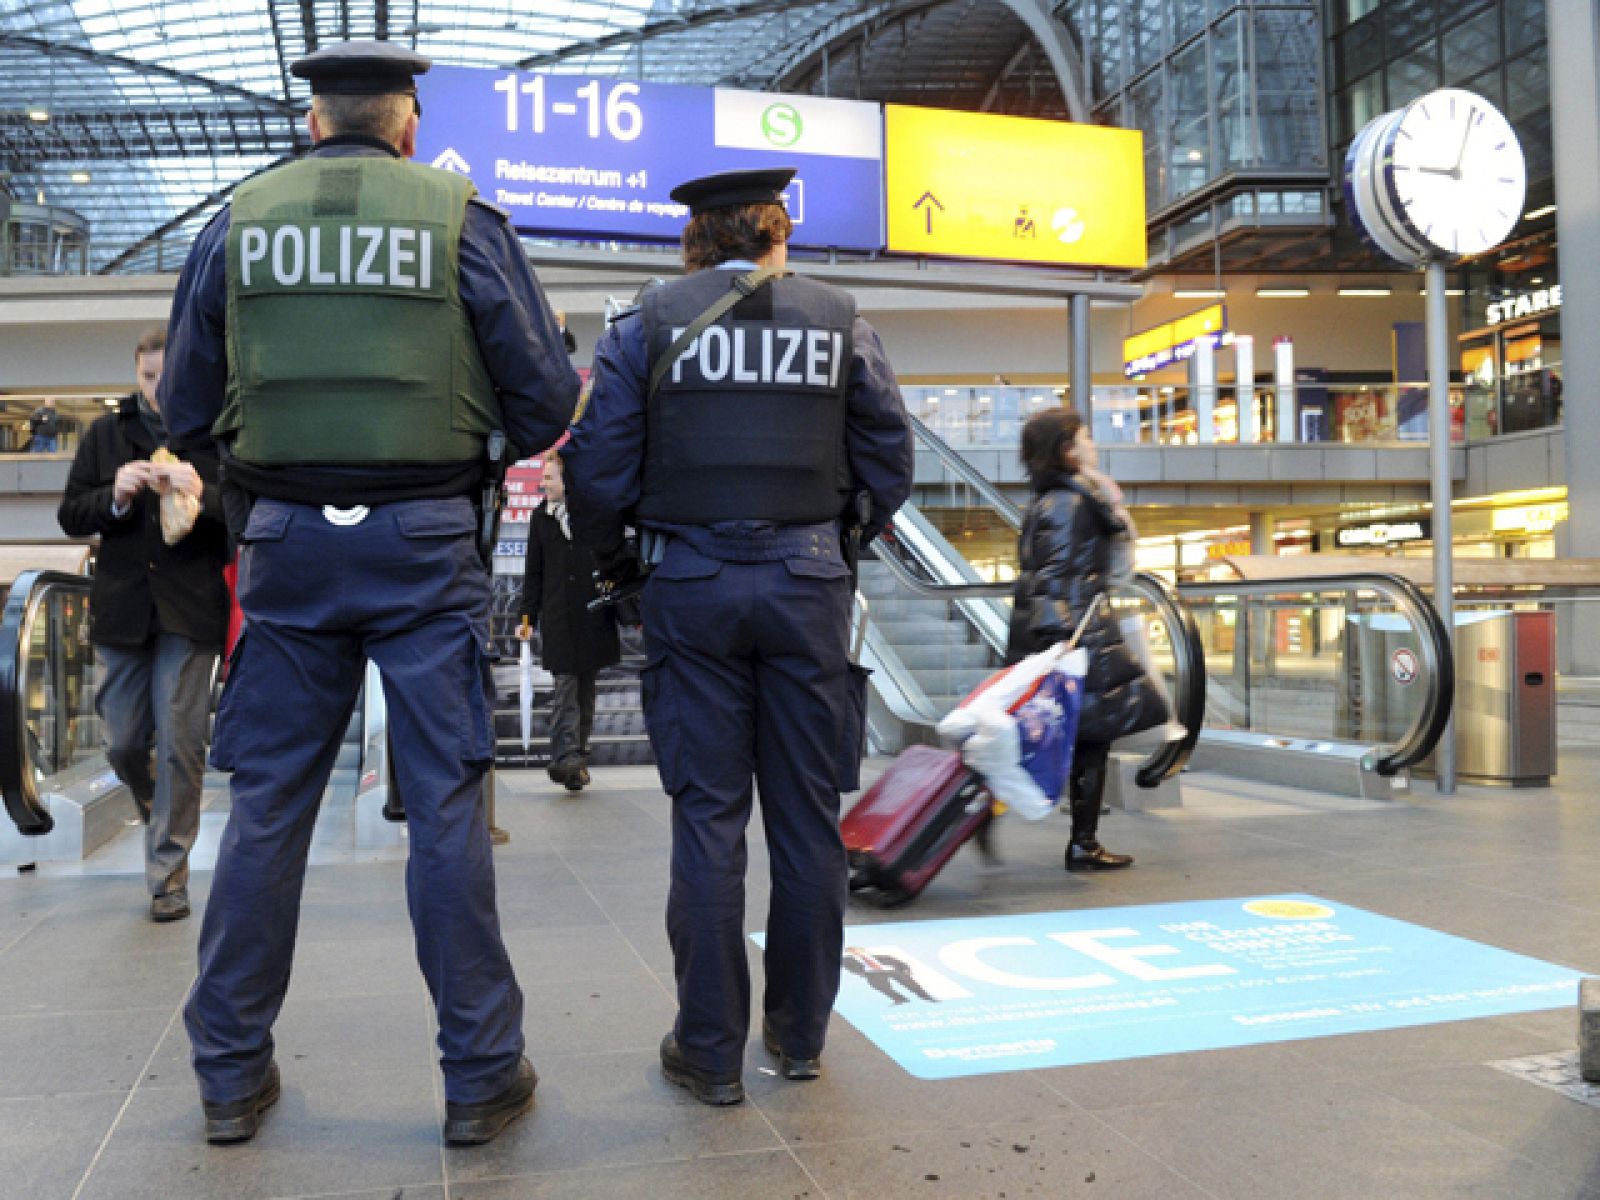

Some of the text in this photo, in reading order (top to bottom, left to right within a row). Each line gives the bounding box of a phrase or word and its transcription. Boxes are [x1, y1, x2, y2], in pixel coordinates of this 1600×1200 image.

[494, 74, 643, 142] 11-16
[765, 105, 799, 142] S
[495, 159, 647, 189] Reisezentrum +1
[496, 189, 534, 206] Travel
[537, 192, 577, 208] Center
[587, 195, 625, 212] Centre
[628, 199, 643, 213] de
[240, 224, 432, 289] POLIZEI
[671, 325, 843, 388] POLIZEI
[866, 928, 1240, 998] ICE
